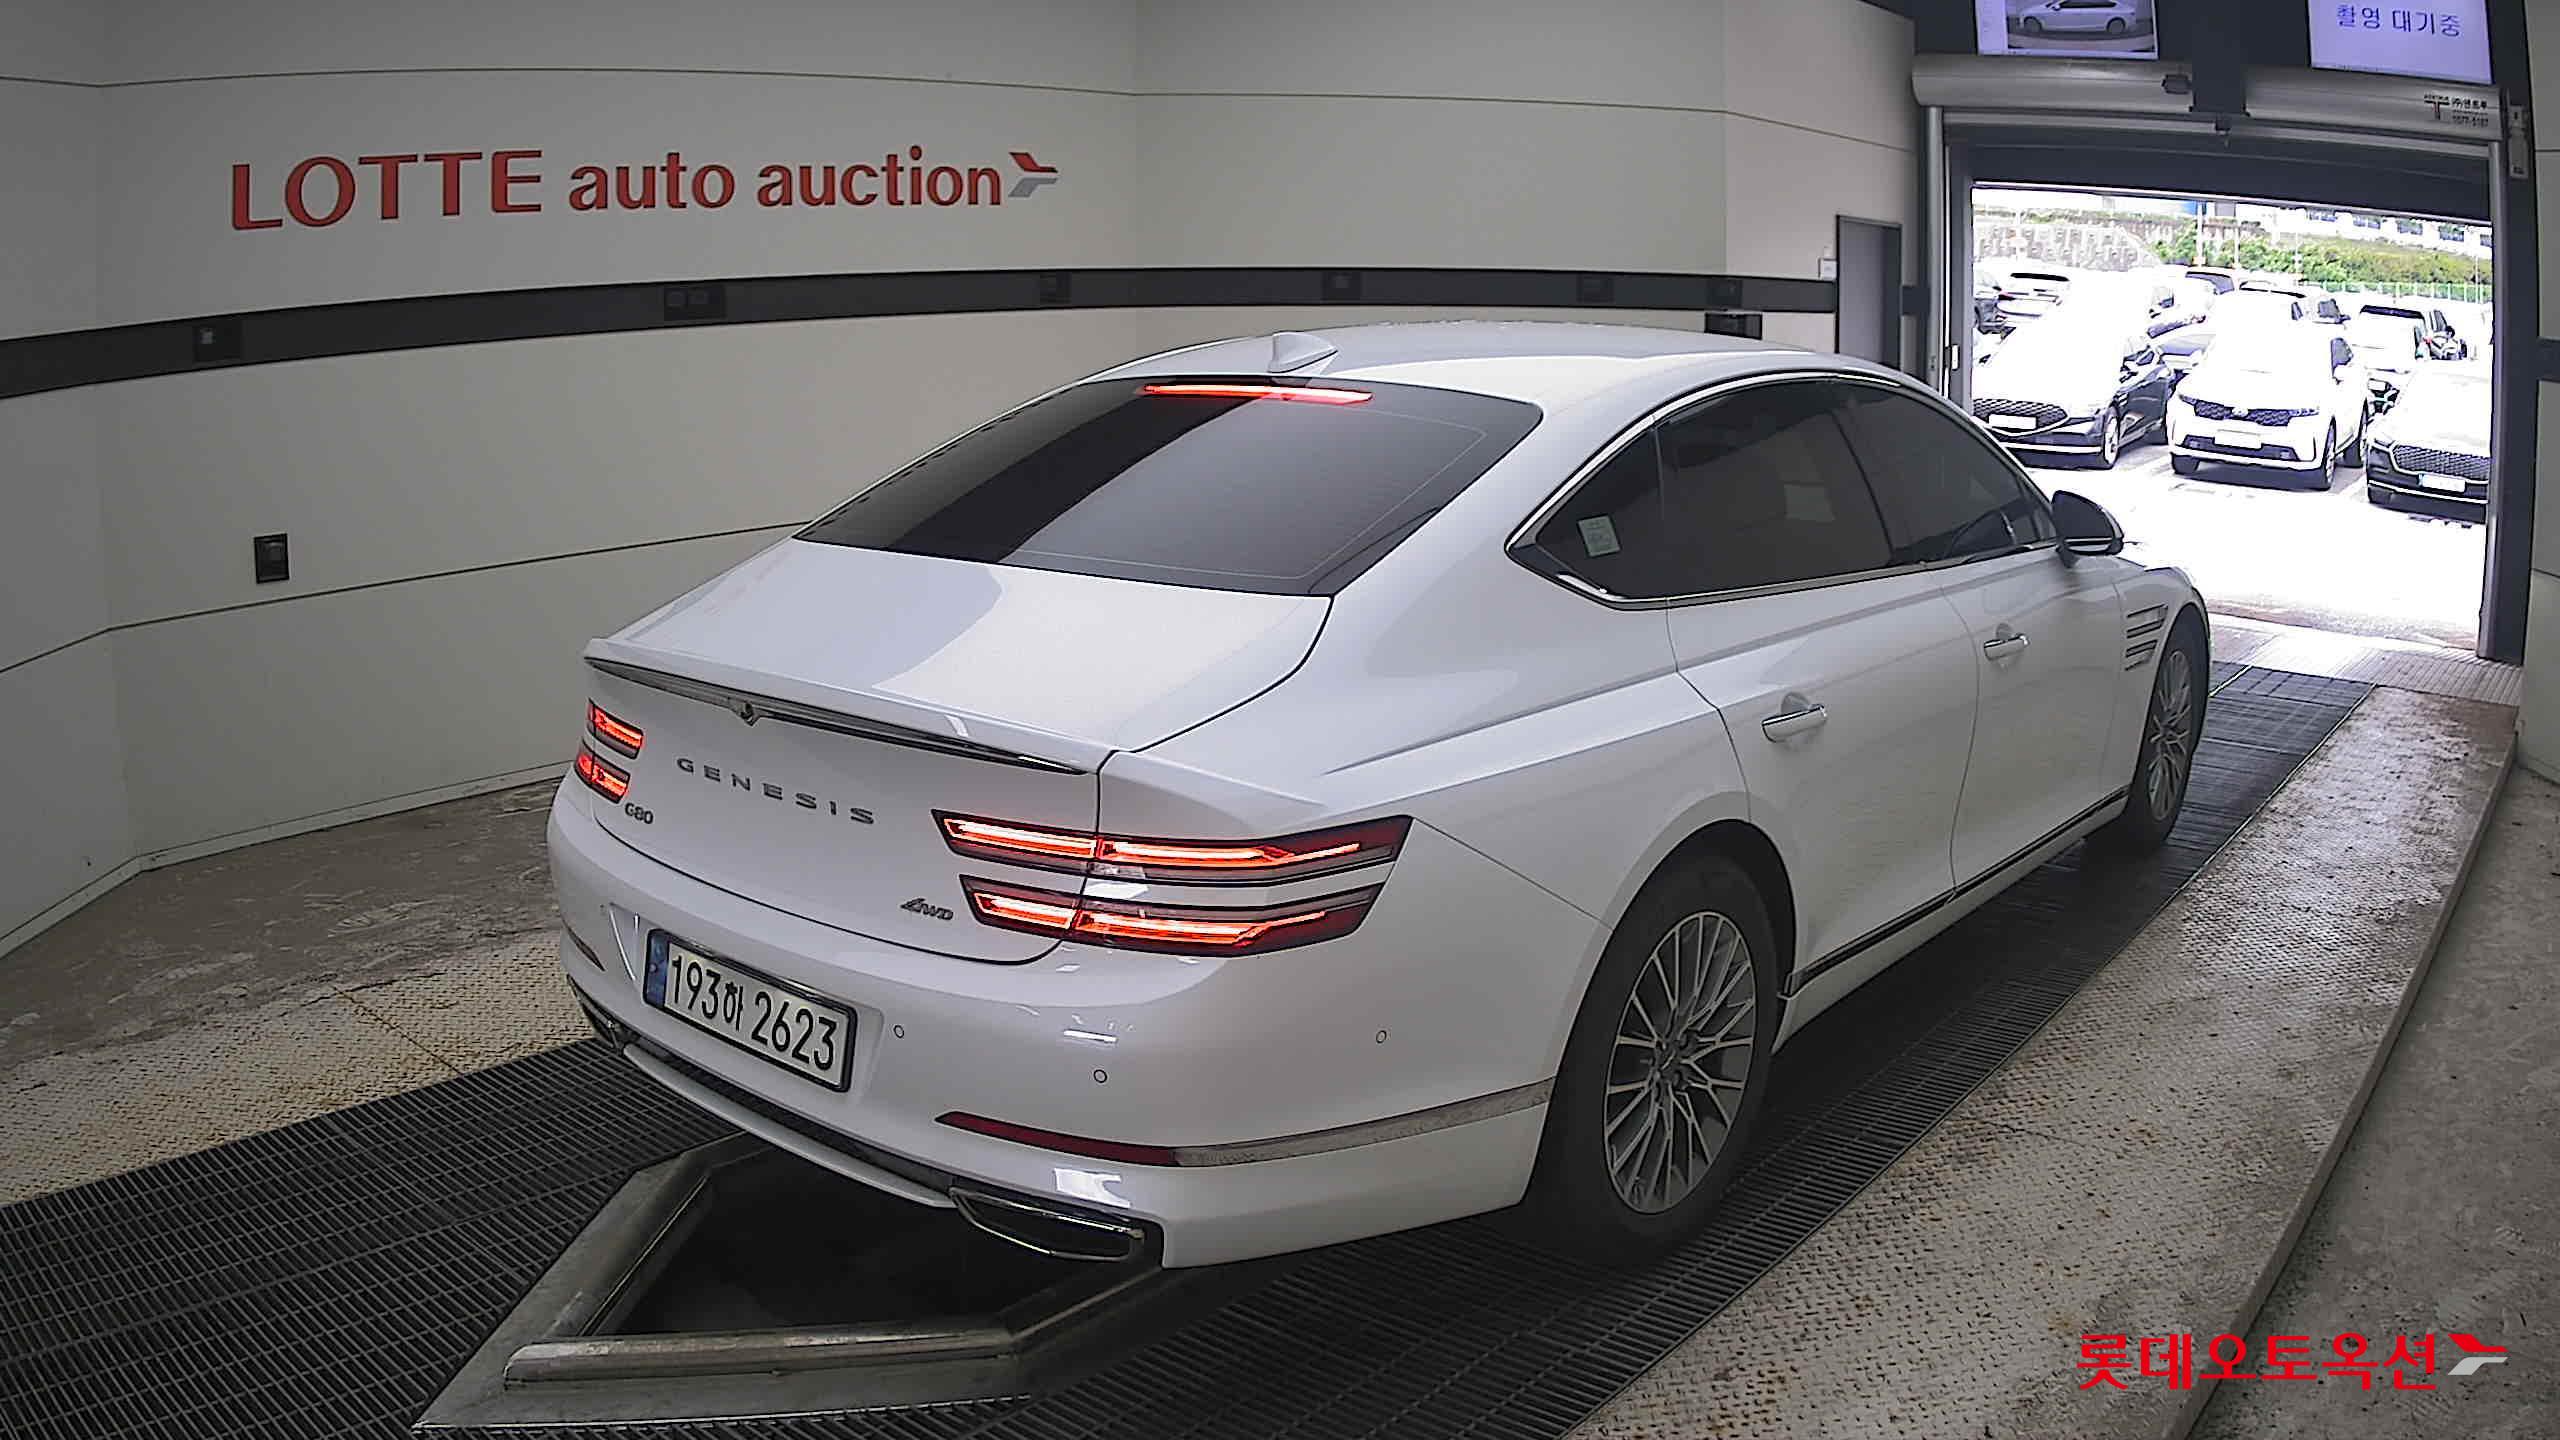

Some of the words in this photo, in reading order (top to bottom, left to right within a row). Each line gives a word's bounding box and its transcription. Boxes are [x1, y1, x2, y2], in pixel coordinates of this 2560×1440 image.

[2337, 4, 2381, 30] 촬영
[2392, 10, 2461, 37] 대기중
[231, 149, 543, 231] LOTTE
[567, 151, 736, 212] auto
[755, 144, 1002, 208] auction
[624, 802, 654, 825] G80
[676, 757, 875, 825] GENESIS
[900, 897, 954, 921] 4WD
[671, 954, 744, 1032] 193하
[750, 990, 838, 1072] 2623
